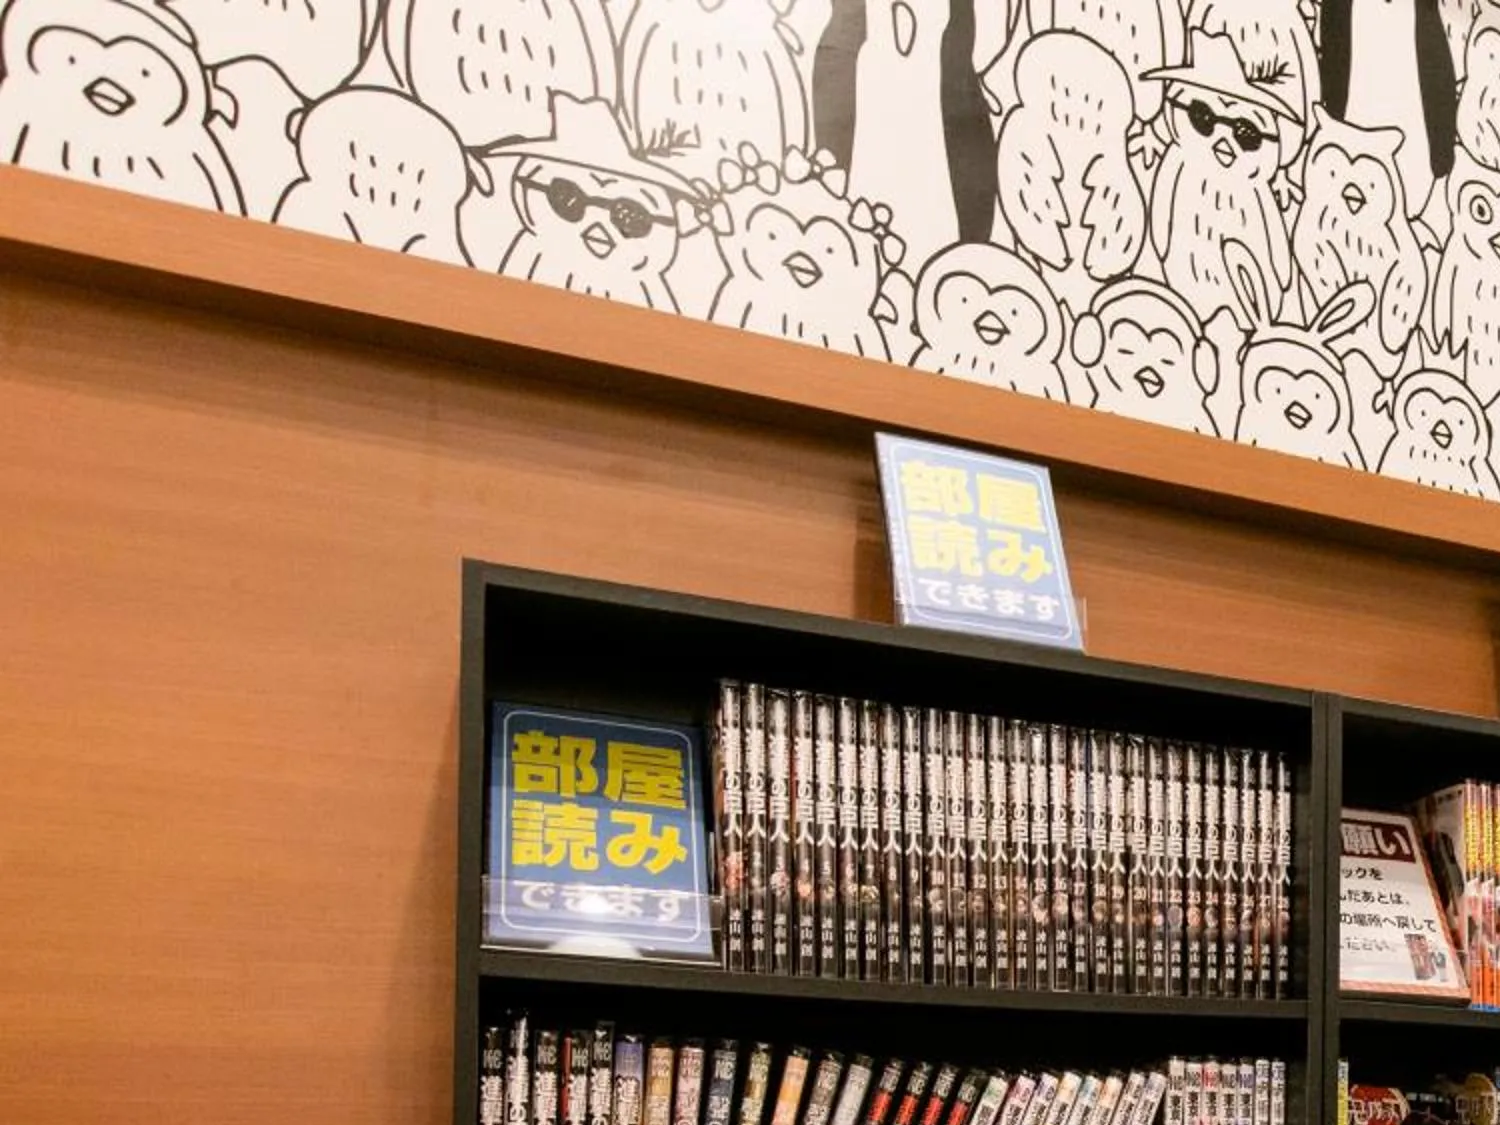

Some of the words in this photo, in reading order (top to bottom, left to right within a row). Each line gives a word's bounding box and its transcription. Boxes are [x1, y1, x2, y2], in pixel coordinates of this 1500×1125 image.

[900, 461, 1047, 533] 部屋
[907, 514, 1053, 583] 読み
[918, 577, 1059, 620] できます
[511, 729, 687, 810] 部屋
[511, 799, 688, 875] 読み
[514, 880, 689, 923] できます
